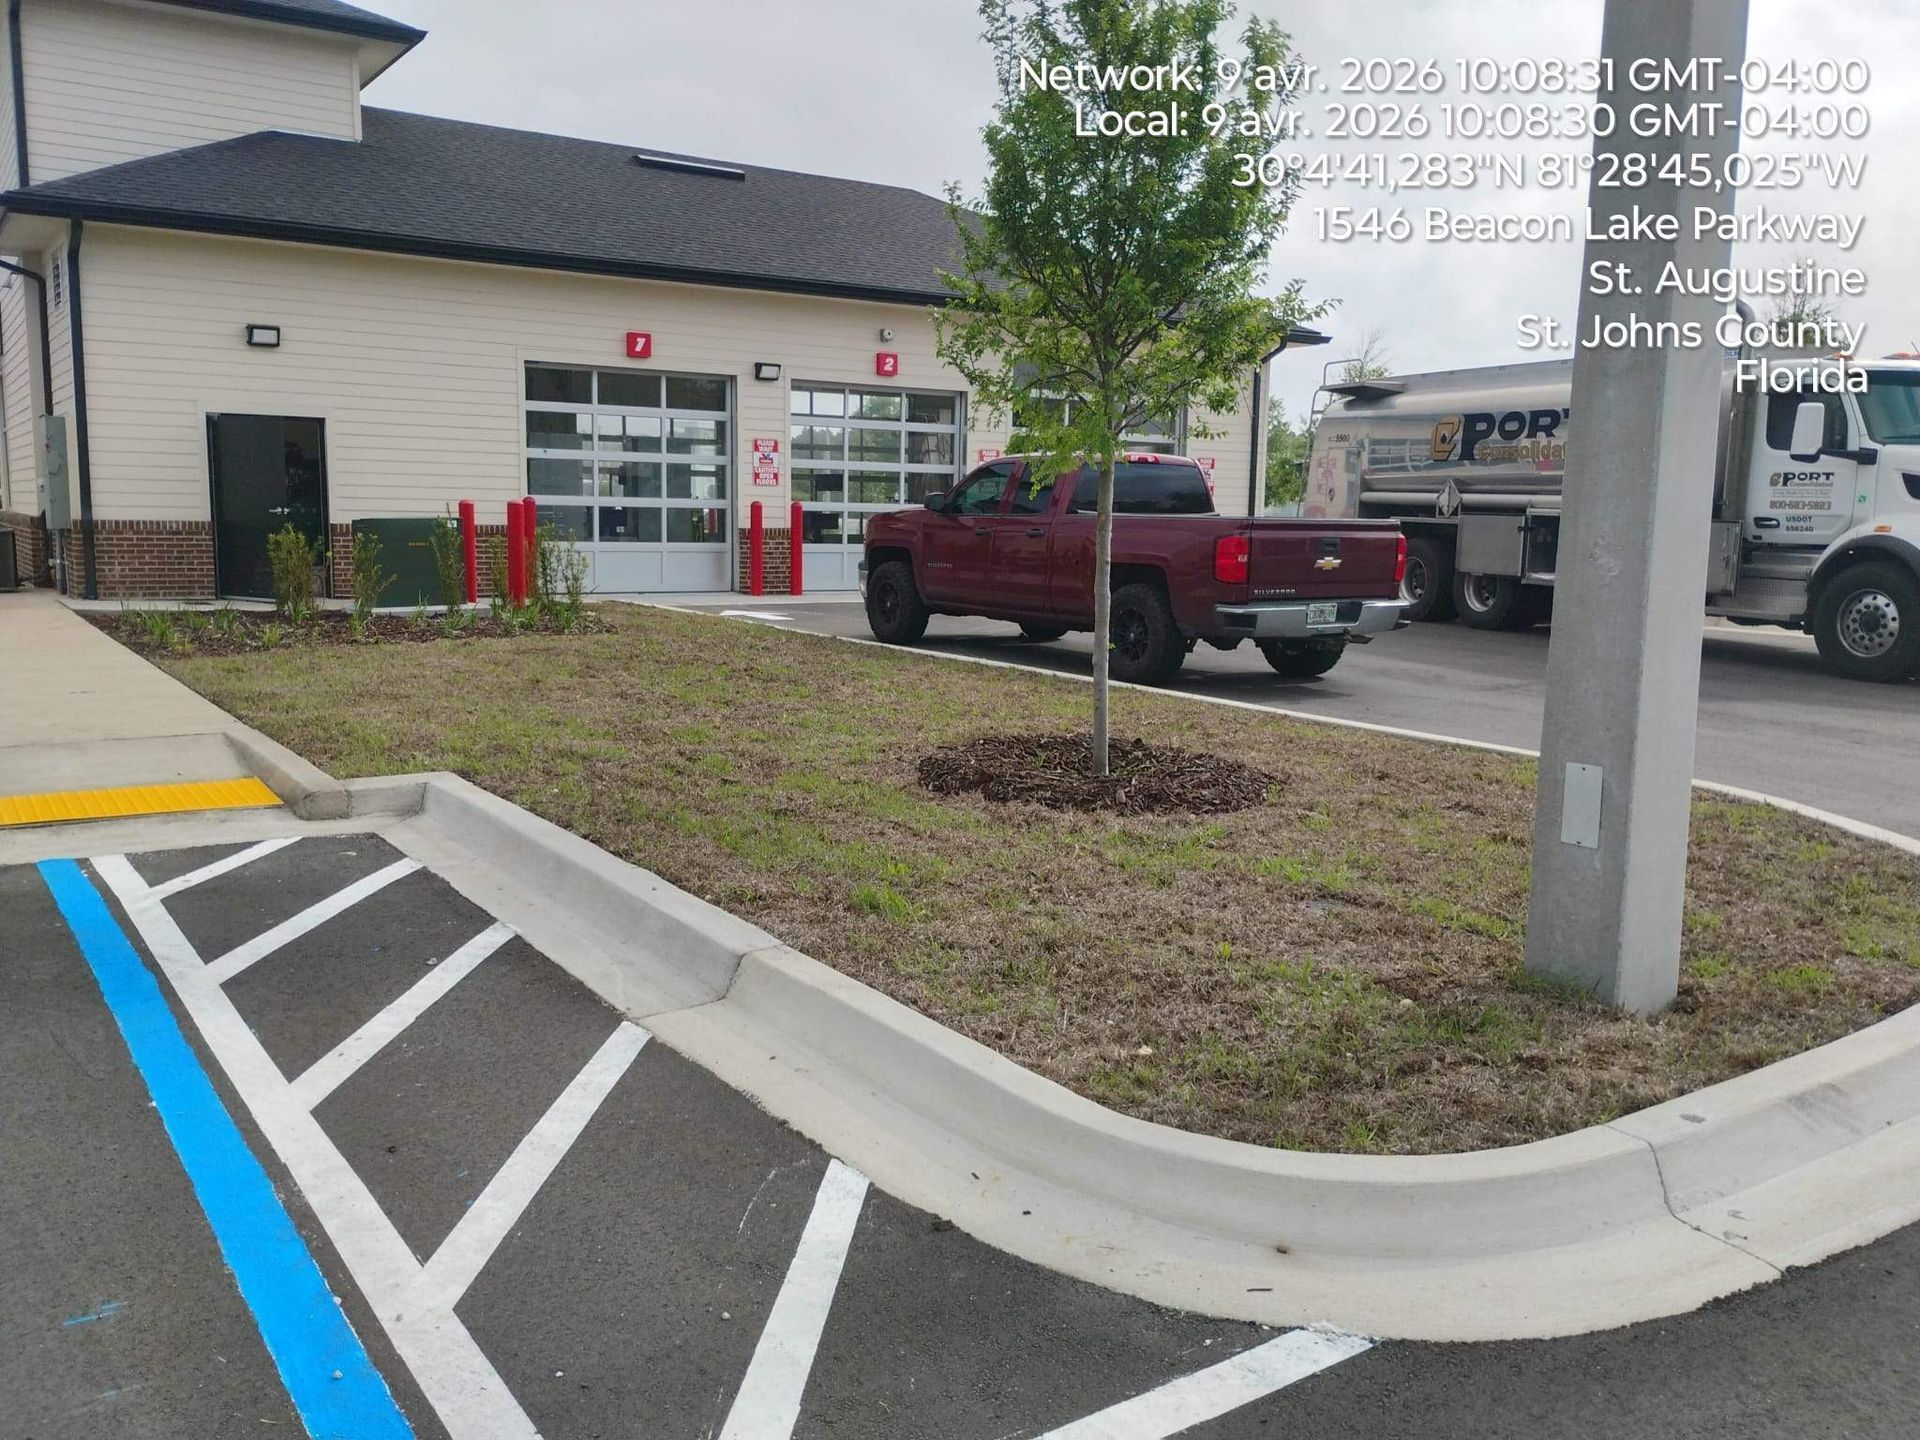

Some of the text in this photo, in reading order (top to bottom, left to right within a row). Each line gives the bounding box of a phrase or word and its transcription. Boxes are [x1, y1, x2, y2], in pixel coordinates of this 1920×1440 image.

[883, 357, 895, 371] 2
[1457, 408, 1570, 461] POR
[1781, 472, 1835, 487] PORT
